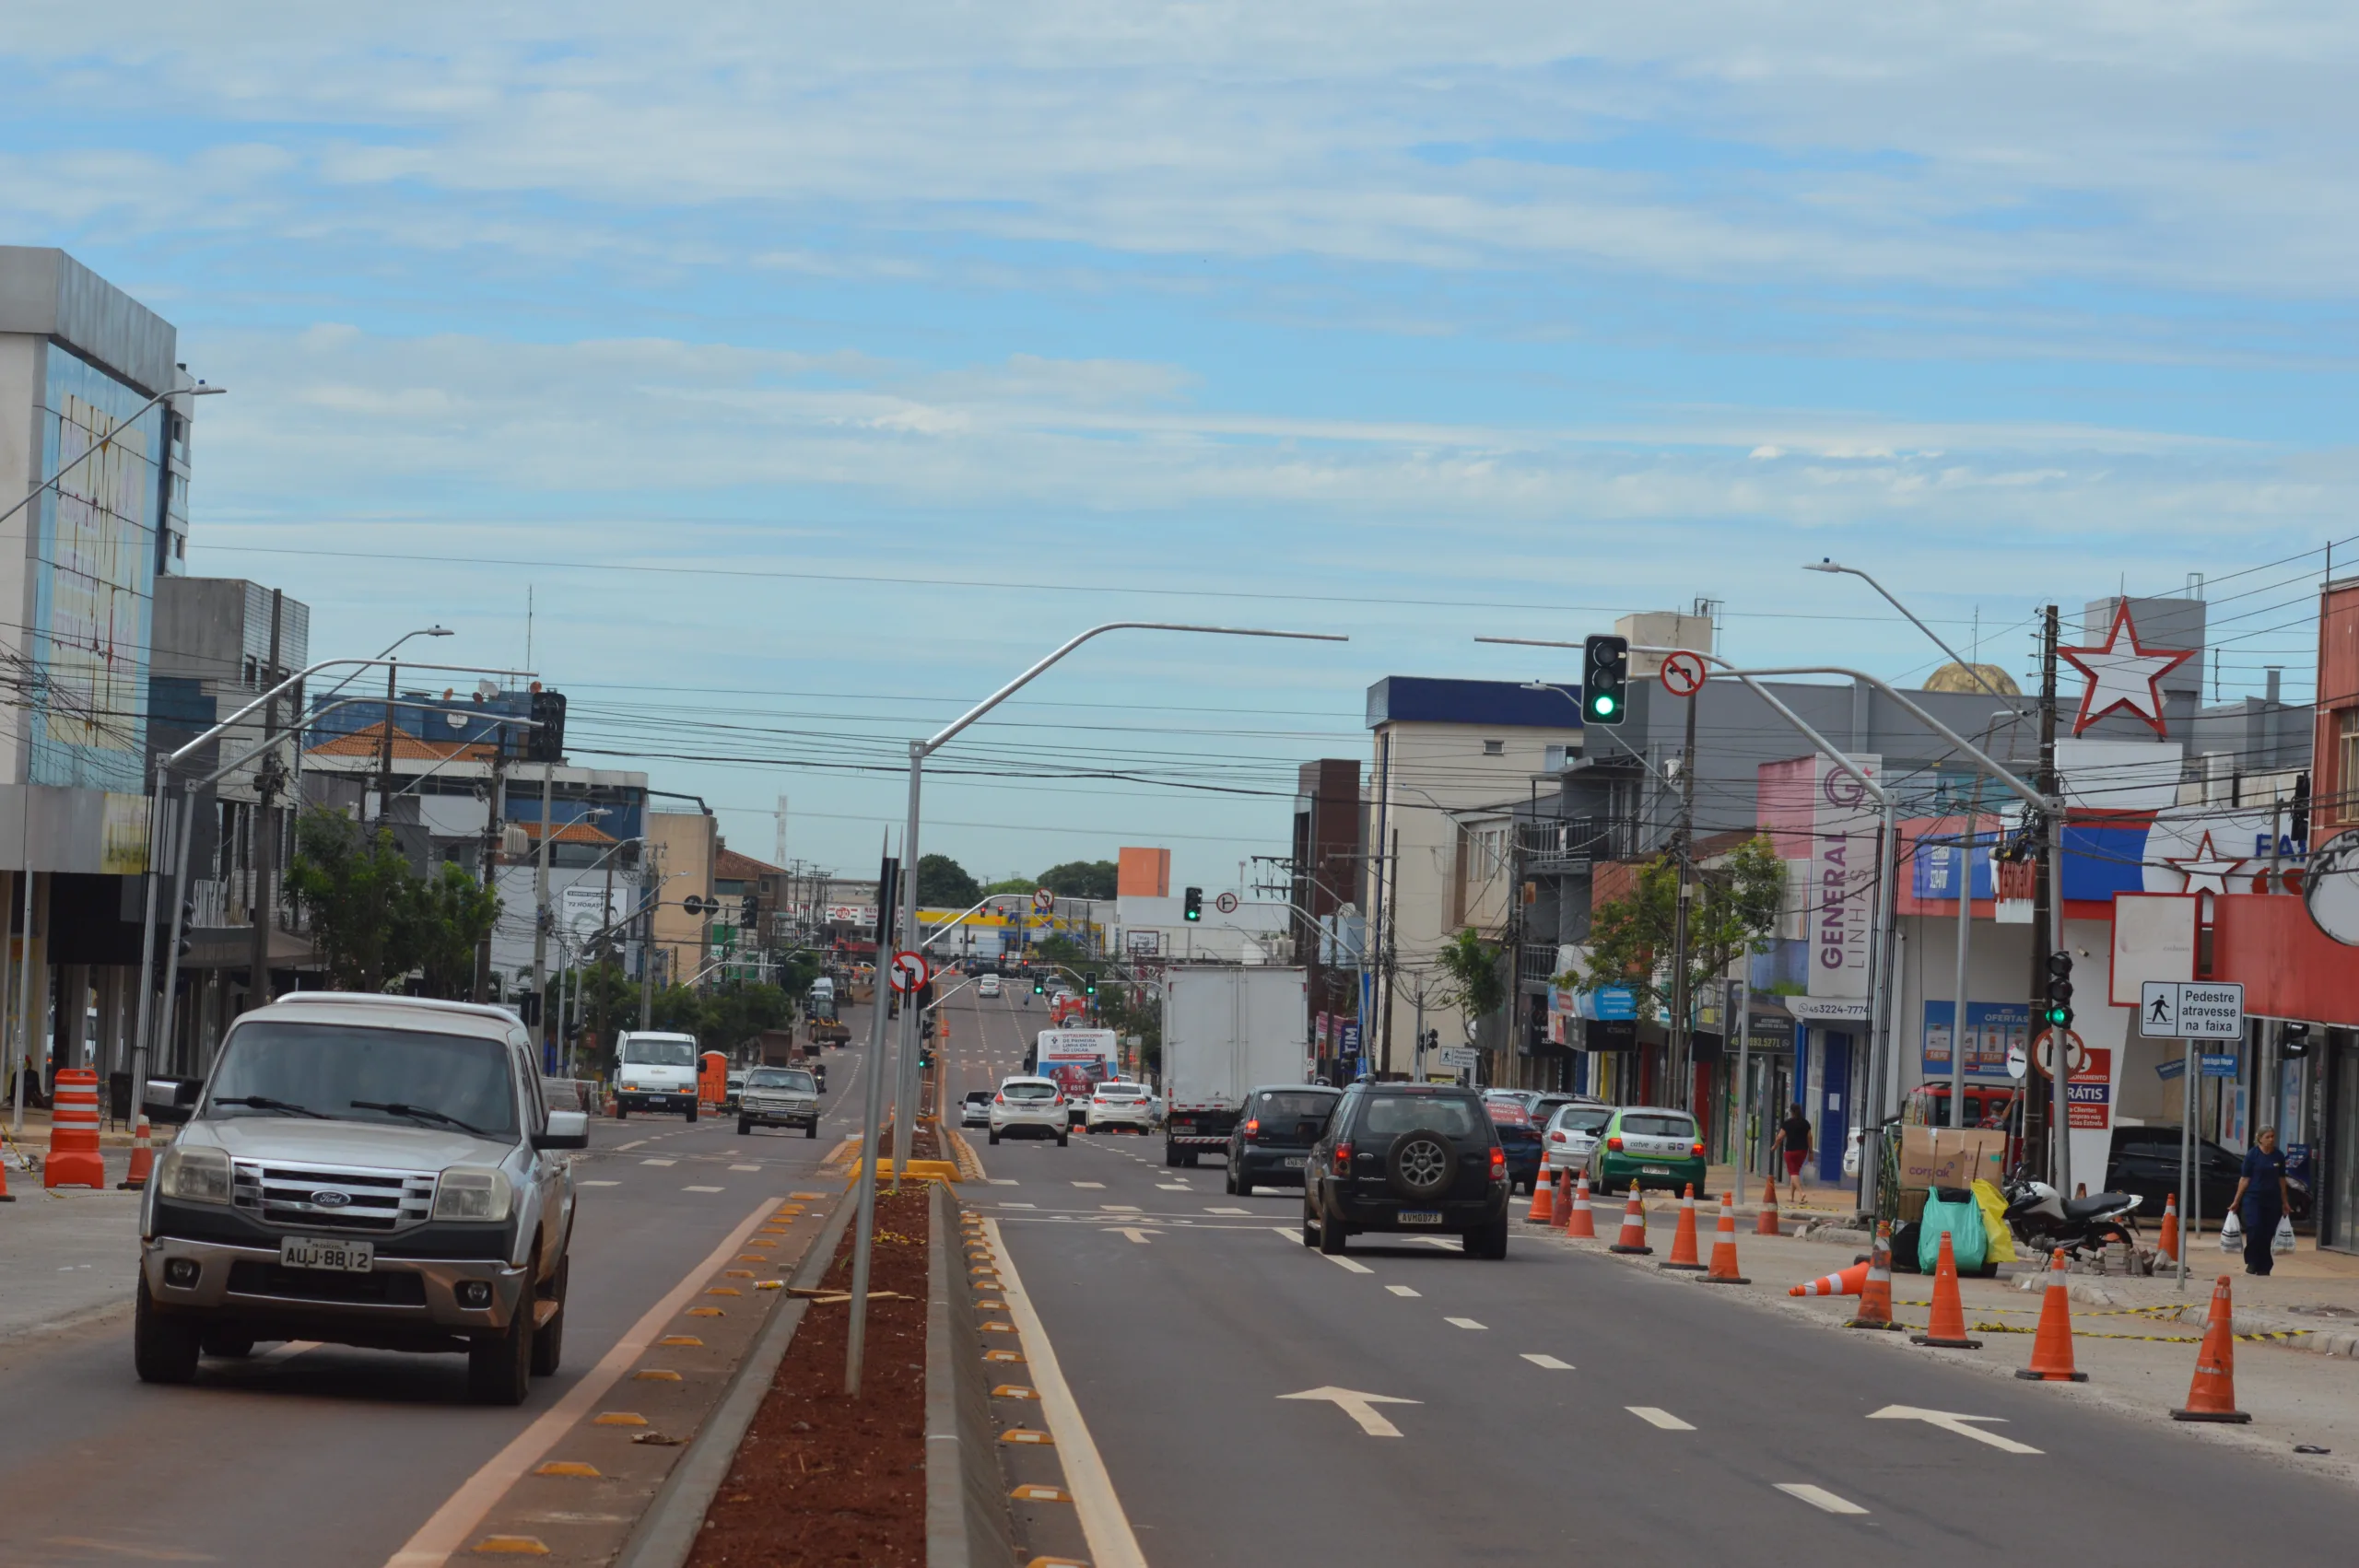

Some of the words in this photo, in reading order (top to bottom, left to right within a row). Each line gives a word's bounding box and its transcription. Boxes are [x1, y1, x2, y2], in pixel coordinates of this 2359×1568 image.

[1820, 829, 1847, 969] GENERAL
[1848, 870, 1867, 968] LINHAS
[2185, 990, 2235, 1003] Pedestre
[2182, 1006, 2236, 1017] atravesse
[1984, 1013, 2029, 1023] OFERTAS
[2185, 1022, 2199, 1031] na
[2206, 1020, 2233, 1031] faixa
[1344, 1027, 1357, 1052] TIM
[2067, 1085, 2103, 1101] RÁTIS
[1630, 1141, 1649, 1149] catve
[319, 1193, 343, 1203] Ford
